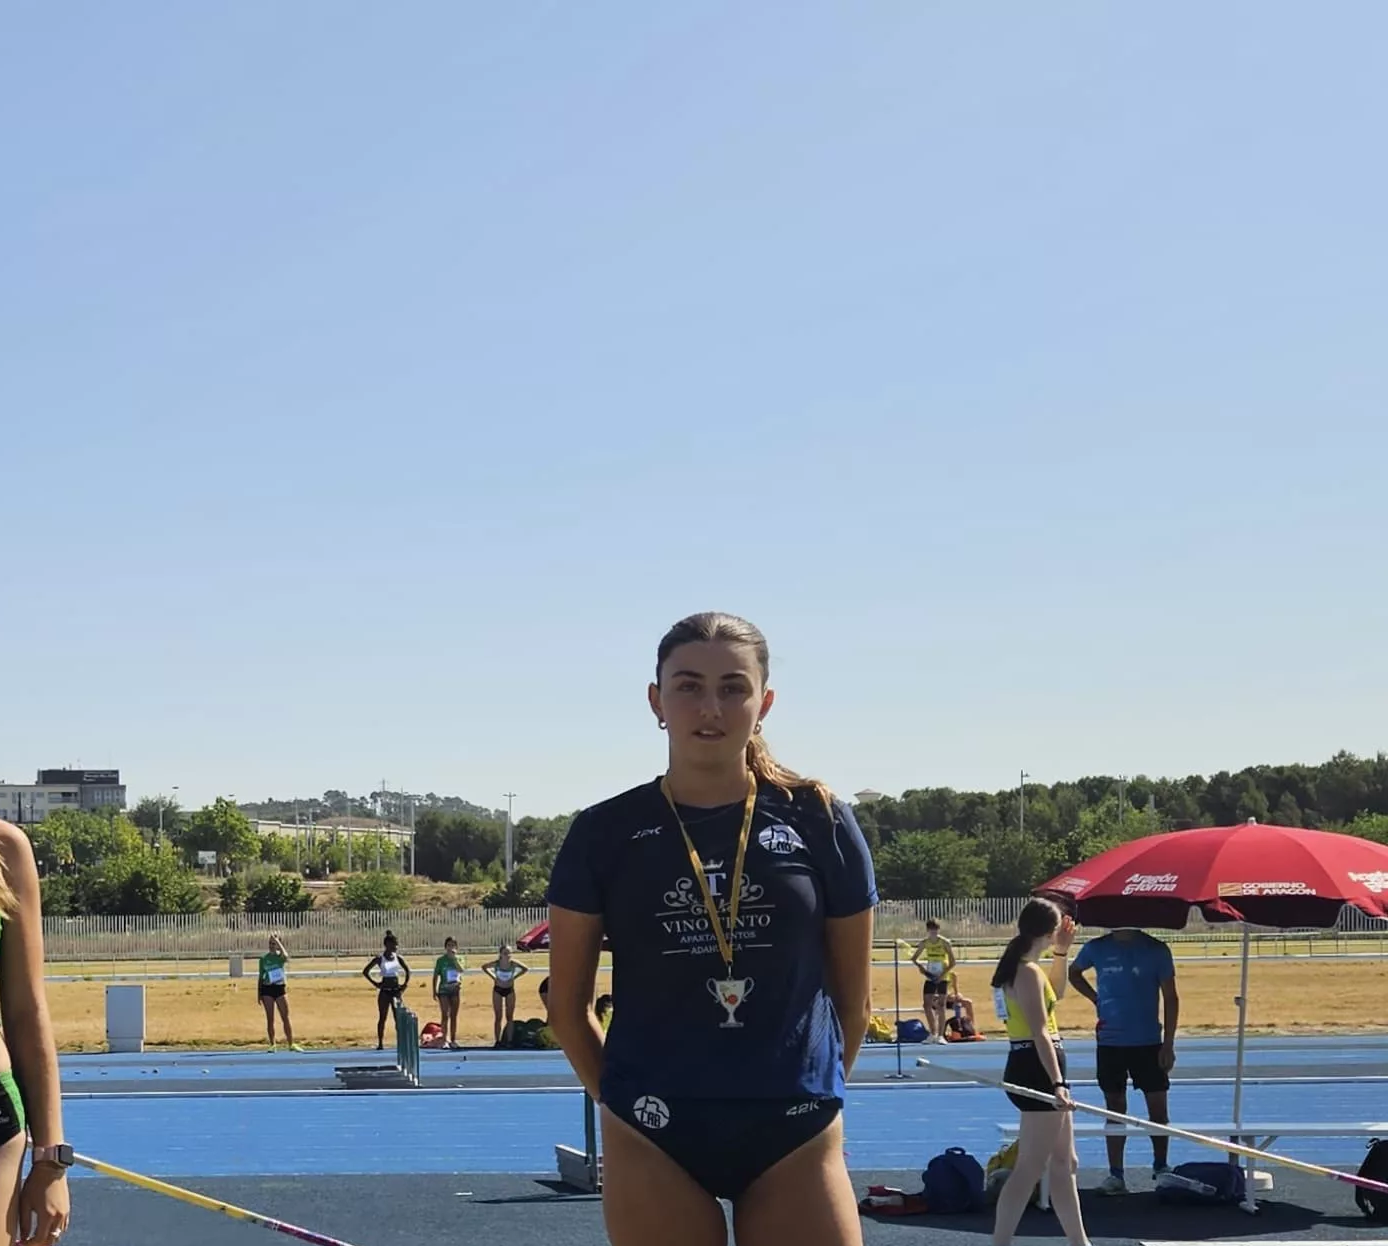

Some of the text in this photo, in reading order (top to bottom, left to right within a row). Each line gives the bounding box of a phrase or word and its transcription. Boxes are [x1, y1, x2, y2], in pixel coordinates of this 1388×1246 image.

[1243, 888, 1260, 896] DE
[662, 914, 771, 934] VINO INTO
[679, 931, 757, 944] APARTAENTOS
